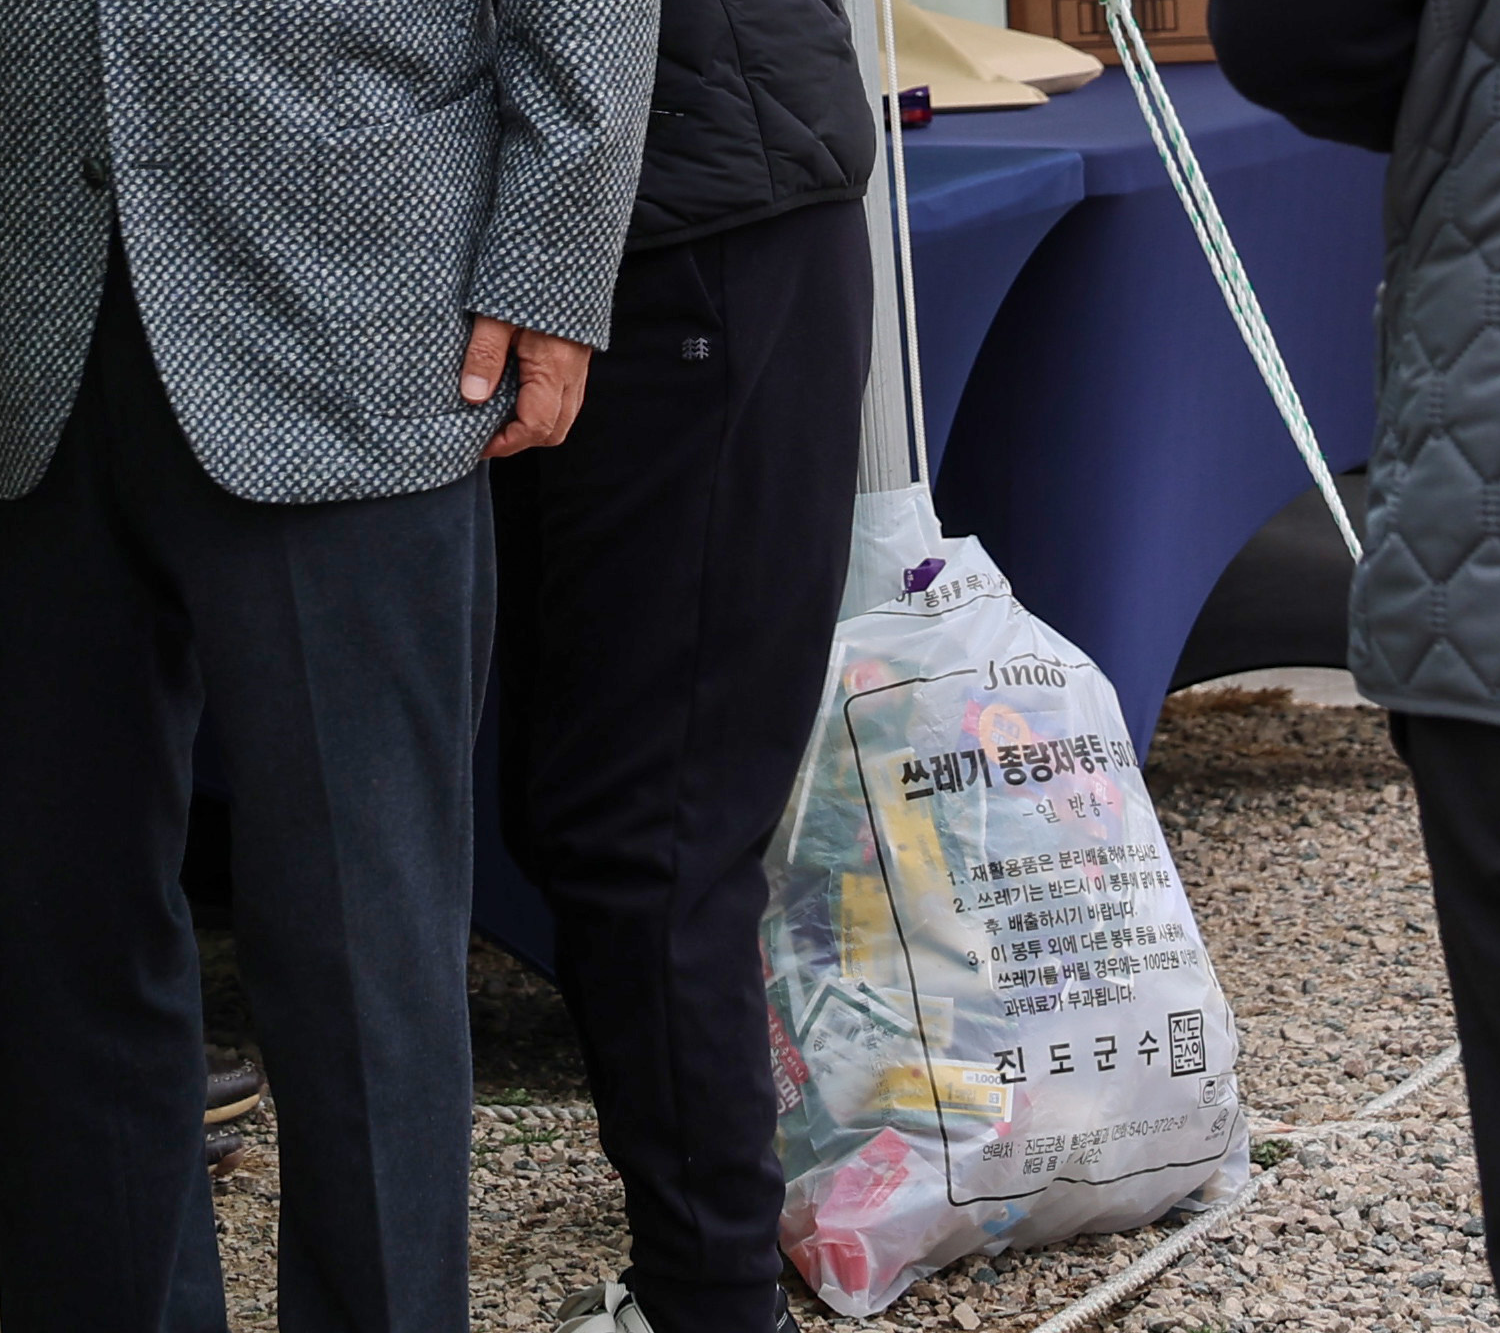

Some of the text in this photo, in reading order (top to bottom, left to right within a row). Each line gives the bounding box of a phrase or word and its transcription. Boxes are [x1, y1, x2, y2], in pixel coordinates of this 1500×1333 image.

[983, 659, 1067, 691] Jindo
[901, 748, 994, 802] 쓰레기
[970, 853, 1054, 883] 재활용품은
[953, 898, 971, 914] 2.
[978, 883, 1044, 910] 쓰레기는
[1048, 879, 1091, 900] 반드시
[1094, 876, 1107, 893] 이
[984, 900, 1138, 936] 후 배출하시기 바랍니다.
[967, 950, 985, 967] 3.
[991, 945, 1007, 964] 이
[1011, 939, 1043, 962] 봉투
[1048, 935, 1078, 957] 외에
[1081, 932, 1108, 951] 다른
[1110, 929, 1132, 949] 봉투
[1136, 925, 1157, 945] 등을
[997, 965, 1058, 990] 쓰레기를
[1062, 960, 1091, 981] 버릴
[1094, 955, 1141, 979] 경우에는
[1143, 949, 1180, 970] 100만원
[1004, 985, 1137, 1018] 과태료가 부과됩니다.
[982, 1141, 1013, 1162] 연락처
[1024, 1134, 1066, 1156] 진도군청
